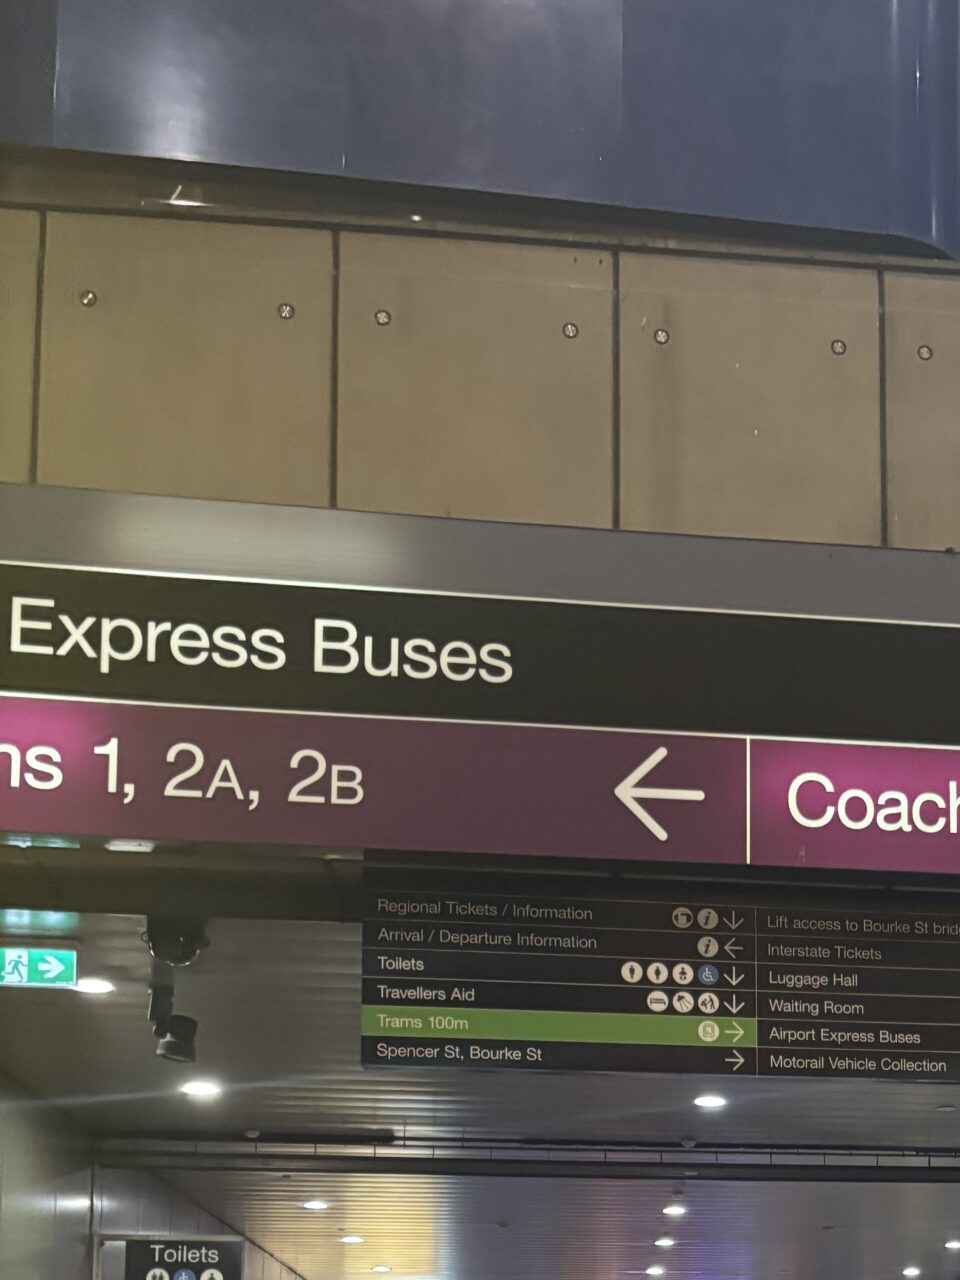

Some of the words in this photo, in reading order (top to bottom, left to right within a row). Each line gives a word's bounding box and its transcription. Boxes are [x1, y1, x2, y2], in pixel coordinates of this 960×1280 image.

[9, 595, 287, 673] Express
[313, 617, 514, 684] Buses
[93, 737, 135, 805] 1,
[164, 742, 259, 811] 2A,
[288, 749, 364, 805] 2B
[377, 898, 441, 918] Regional
[446, 901, 498, 917] Tickets
[512, 903, 593, 921] Information
[767, 915, 789, 930] Lift
[793, 918, 841, 932] access
[845, 919, 859, 932] to
[863, 919, 911, 935] Bourke
[914, 922, 930, 935] St
[377, 928, 424, 944] Arrival
[439, 930, 512, 948] Departure
[517, 932, 597, 950] Information
[767, 943, 831, 960] Interstate
[834, 946, 882, 961] Tickets
[378, 956, 425, 972] Toilets
[769, 971, 829, 989] Luggage
[833, 973, 858, 988] Hall
[377, 985, 446, 1001] Travellers
[451, 986, 475, 1002] Aid
[769, 999, 819, 1017] Waiting
[824, 1000, 865, 1016] Room
[377, 1014, 423, 1030] Trams
[428, 1016, 469, 1031] 100m
[769, 1026, 816, 1044] Airport
[820, 1028, 875, 1045] Express
[879, 1030, 921, 1045] Buses
[376, 1043, 440, 1062] Spencer
[444, 1045, 464, 1062] St,
[469, 1046, 522, 1062] Bourke
[526, 1048, 543, 1063] St
[770, 1055, 825, 1071] Motorail
[828, 1056, 877, 1071] Vehicle
[881, 1058, 947, 1074] Collection
[150, 1244, 220, 1264] Toilets
